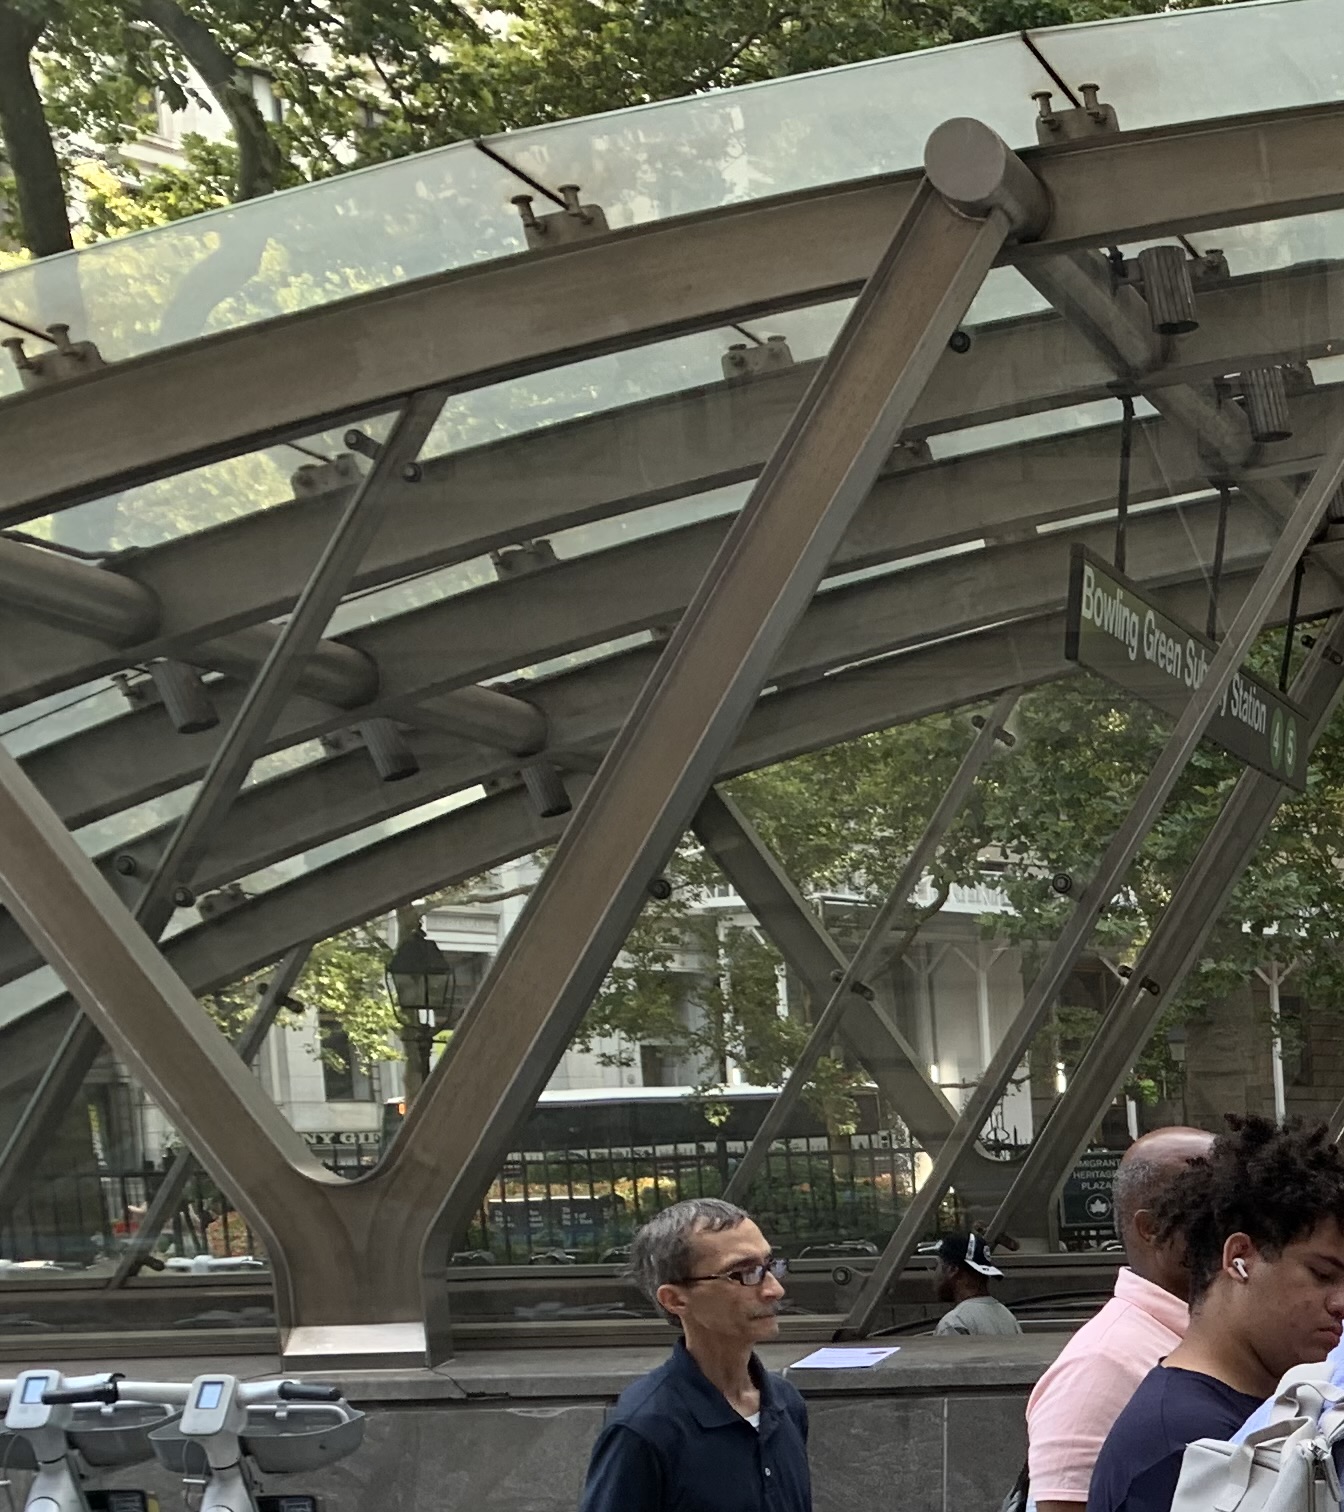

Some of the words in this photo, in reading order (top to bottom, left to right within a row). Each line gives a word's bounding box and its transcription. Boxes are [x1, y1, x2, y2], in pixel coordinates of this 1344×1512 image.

[1082, 564, 1140, 661] Bowling
[1144, 609, 1181, 679] Green
[1185, 638, 1231, 717] Suby
[1231, 671, 1267, 735] Station
[1081, 1181, 1112, 1190] PLAZA
